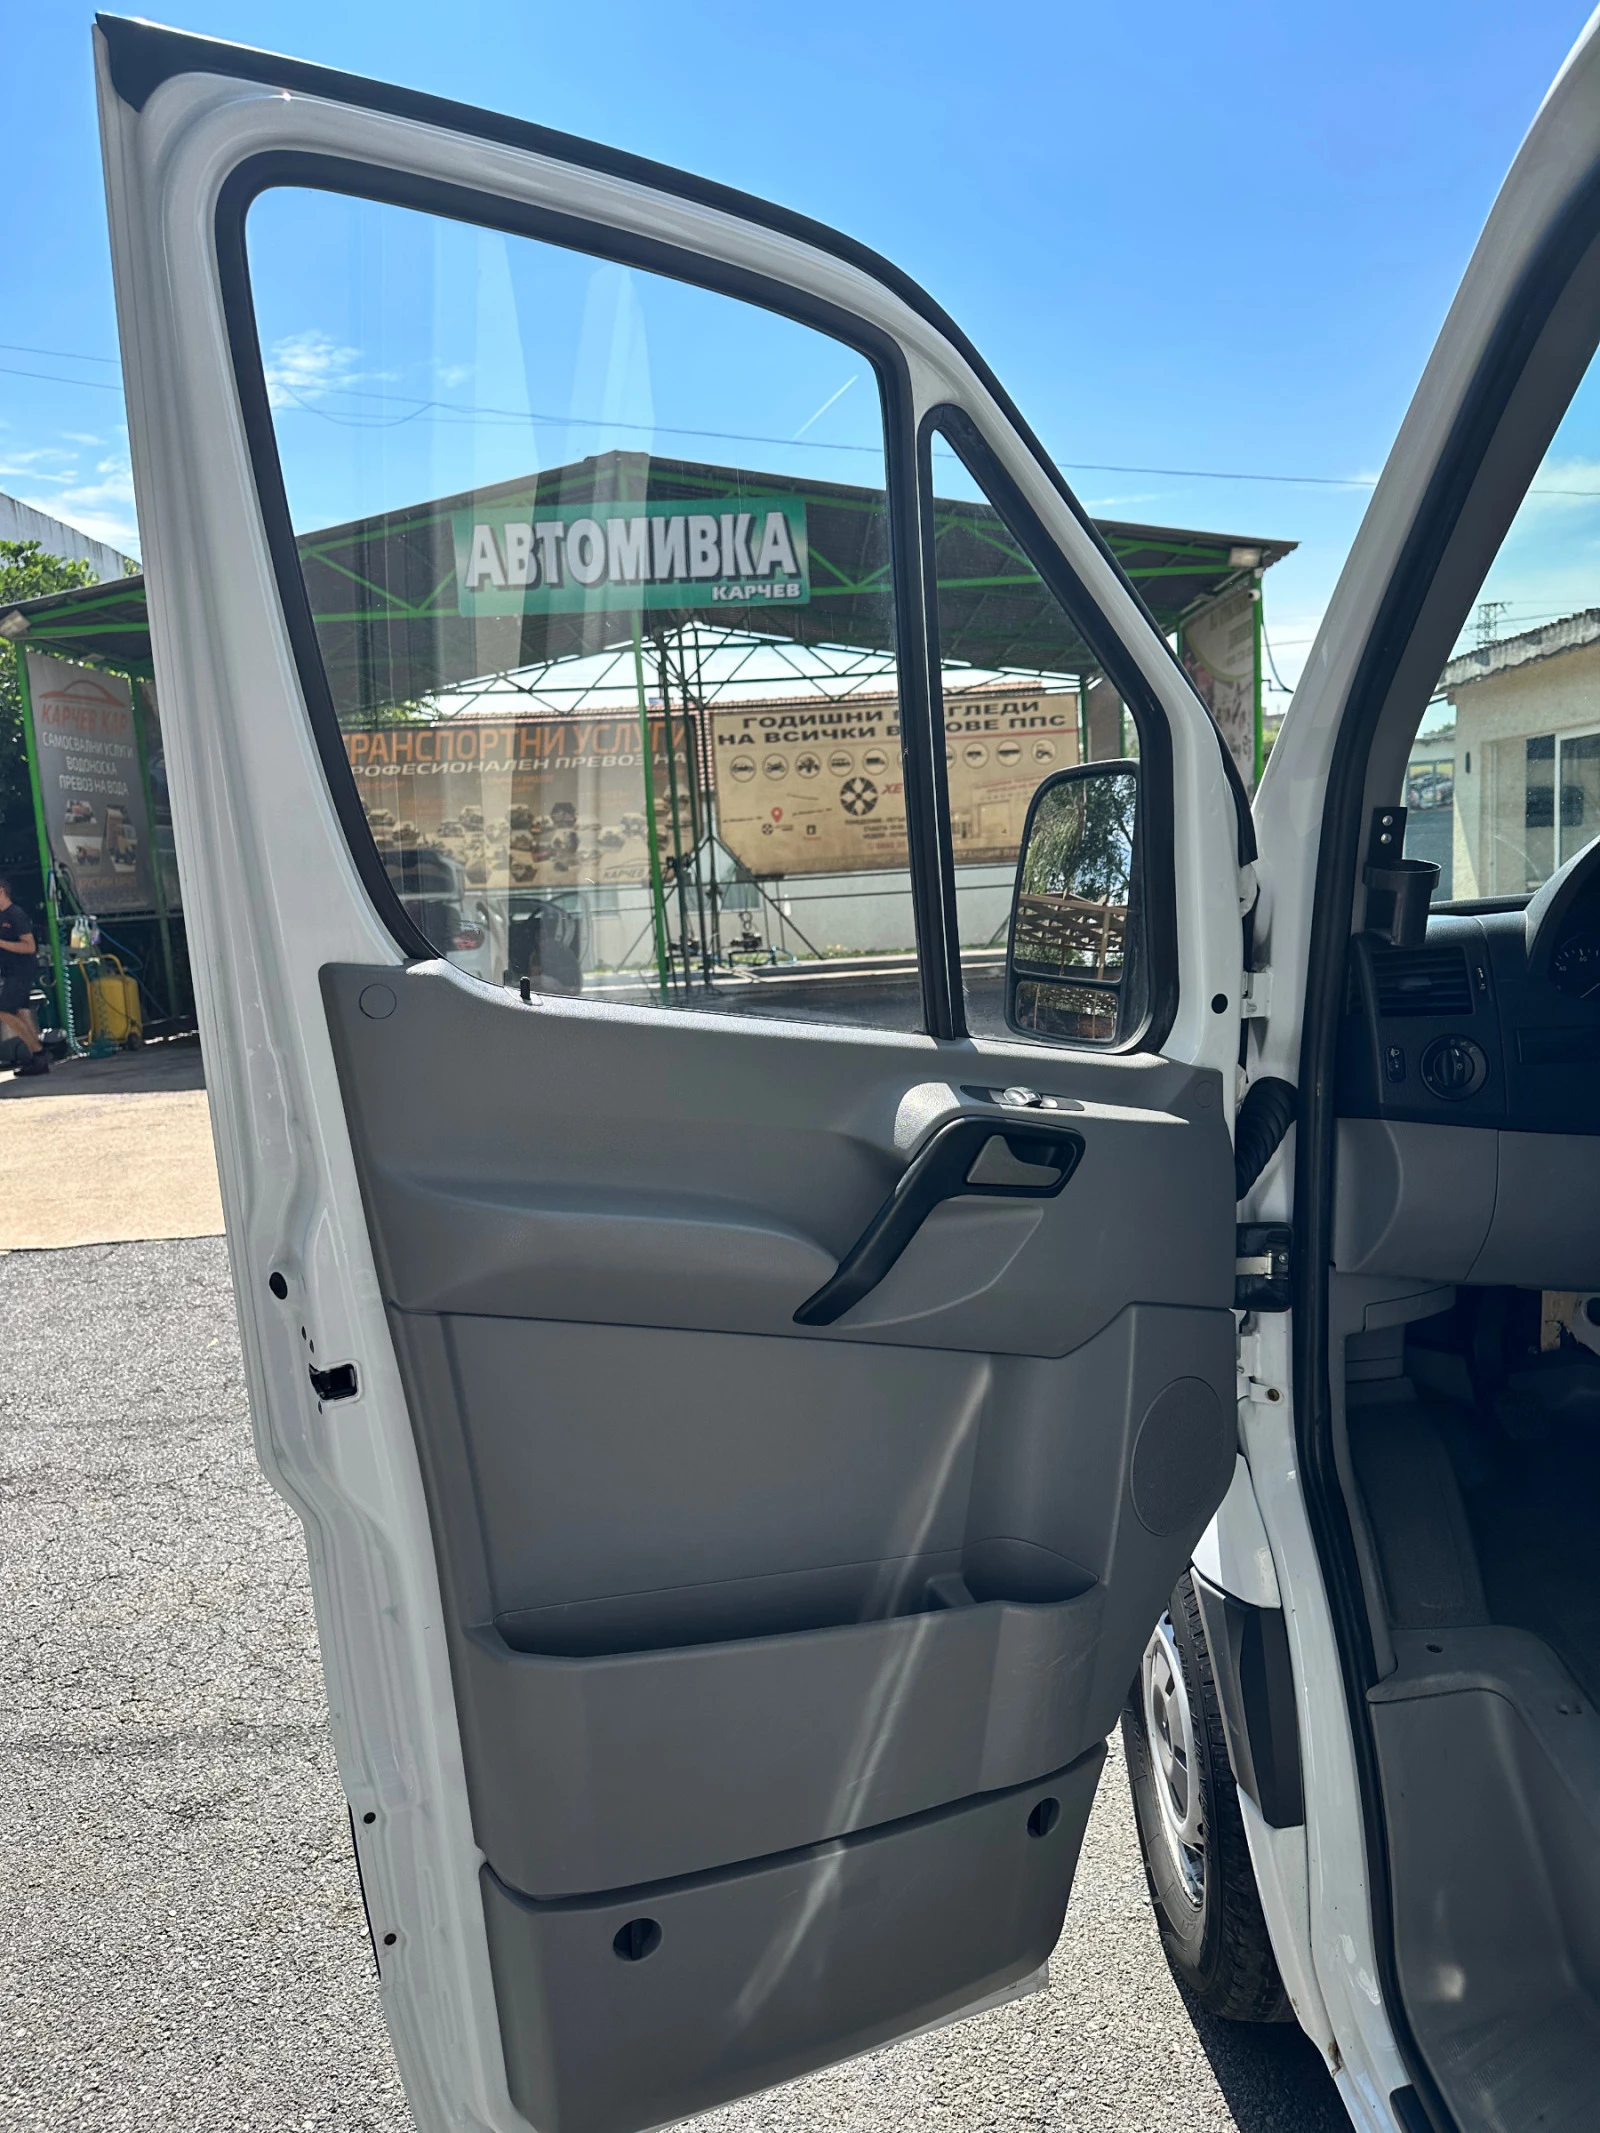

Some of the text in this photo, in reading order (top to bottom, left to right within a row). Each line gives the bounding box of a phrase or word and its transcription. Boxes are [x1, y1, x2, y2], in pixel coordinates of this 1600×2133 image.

[465, 511, 799, 589] АВТОМИВКА
[712, 583, 801, 601] КАРЧЕВ
[42, 703, 97, 731] КАРЧЕВ
[742, 710, 883, 729] ГОДИШНИ
[718, 714, 1066, 746] НА ВСИЧКИ ВОВЕ ППС
[351, 757, 549, 778] РОФЕСИОНАЛЕН
[59, 773, 94, 793] ПРЕВОЗ
